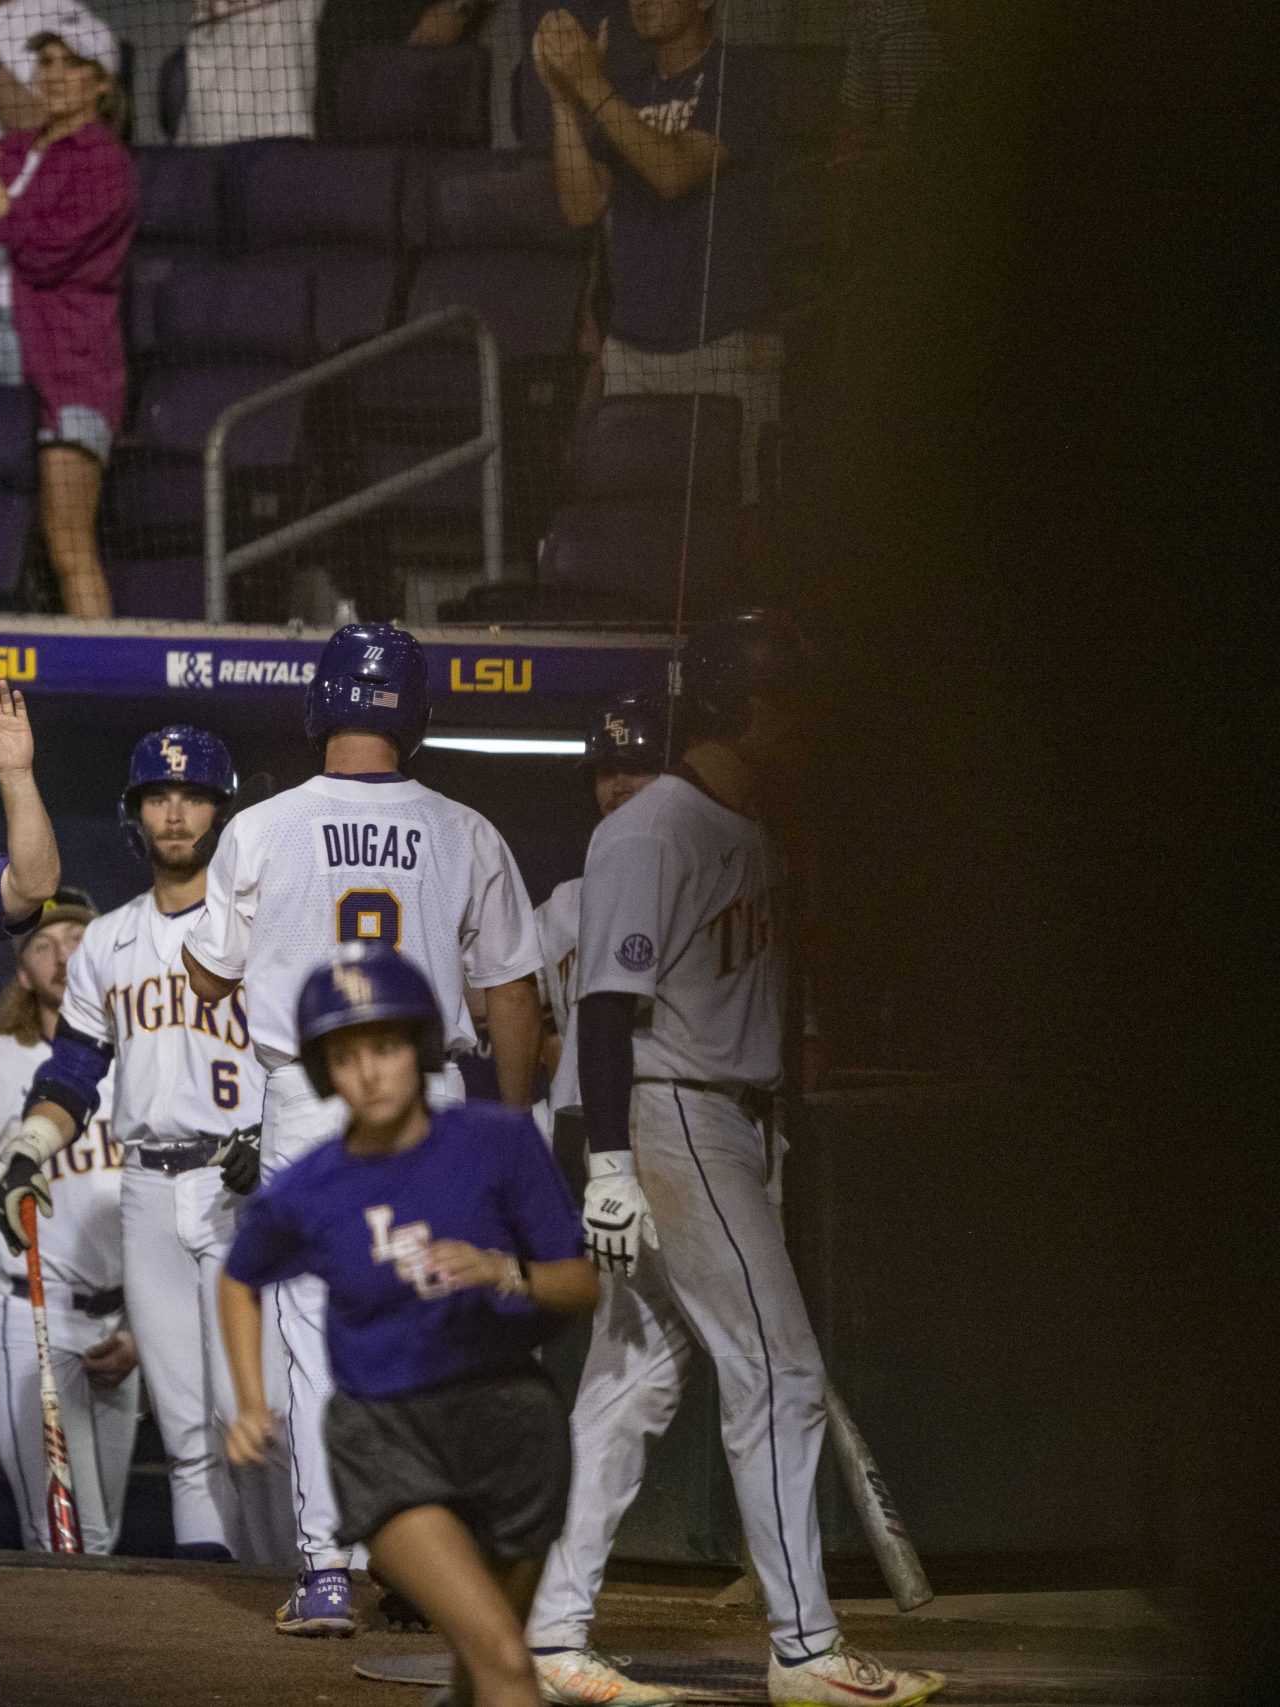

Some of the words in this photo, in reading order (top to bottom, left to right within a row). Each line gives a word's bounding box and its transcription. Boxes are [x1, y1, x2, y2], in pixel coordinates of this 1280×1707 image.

[218, 660, 315, 683] RENTALS
[451, 657, 532, 692] LSU
[350, 686, 361, 702] 8
[604, 712, 630, 745] LSU
[160, 738, 188, 772] LSU
[322, 823, 422, 870] DUGAS
[104, 973, 251, 1052] TIGERS
[210, 1059, 241, 1111] 6
